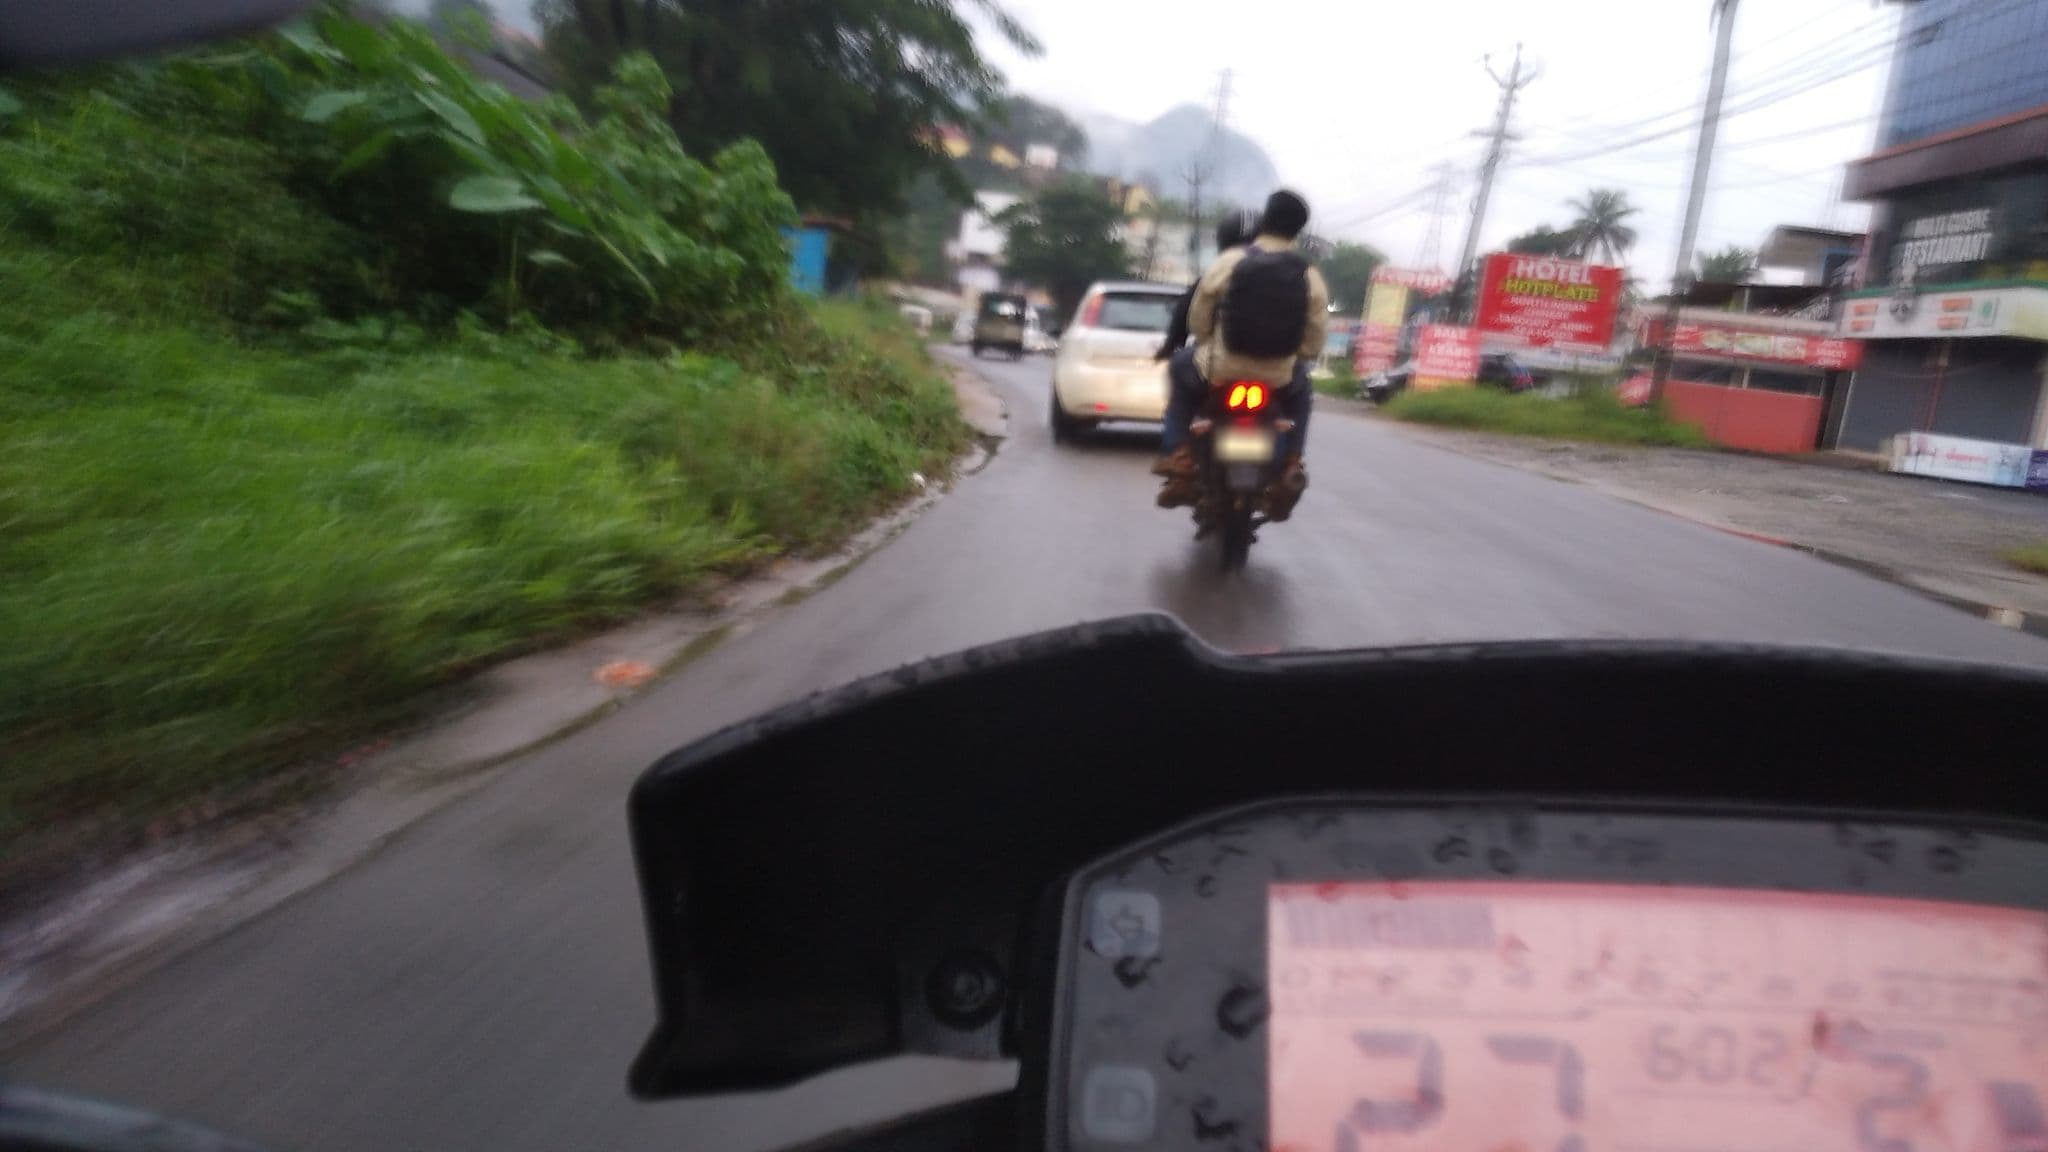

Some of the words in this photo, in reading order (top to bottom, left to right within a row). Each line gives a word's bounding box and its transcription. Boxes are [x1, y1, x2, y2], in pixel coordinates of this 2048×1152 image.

[1902, 232, 1992, 266] RESTAURANT
[1513, 259, 1593, 285] HOTEL
[1644, 1022, 1787, 1085] 602
